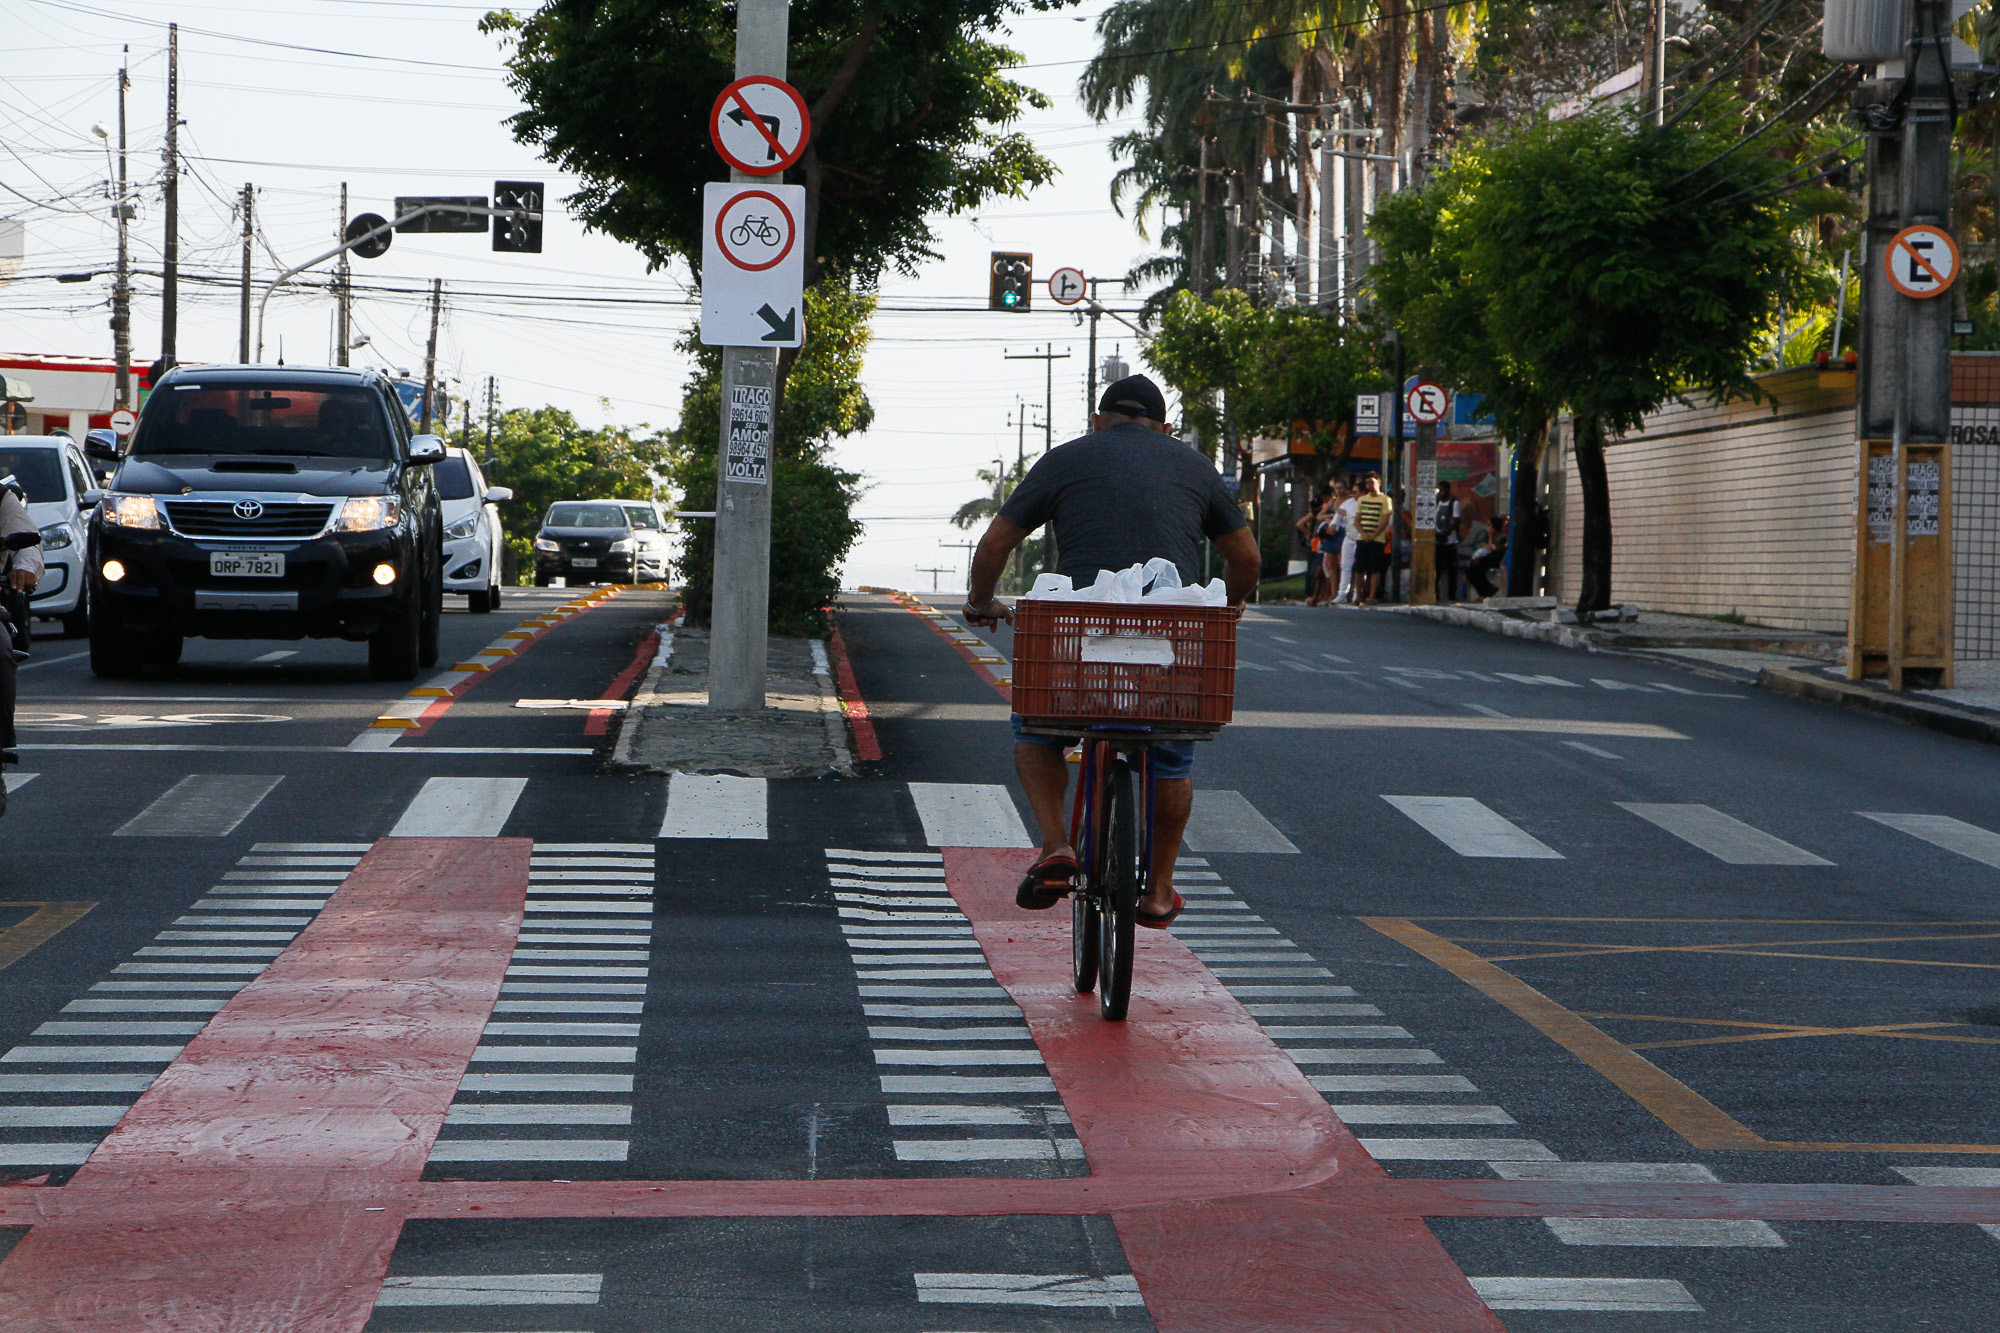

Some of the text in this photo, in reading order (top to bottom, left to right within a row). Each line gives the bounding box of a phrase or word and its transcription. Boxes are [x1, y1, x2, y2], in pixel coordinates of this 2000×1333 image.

[734, 387, 770, 405] TRAGO
[731, 408, 753, 421] 99614
[731, 428, 768, 442] AMOR
[1951, 425, 1999, 445] ROSA
[729, 441, 750, 456] 98964
[728, 462, 766, 478] VOLTA
[1908, 464, 1939, 478] TRAGO
[1909, 494, 1938, 505] AMOR
[1908, 520, 1938, 531] VOLTA
